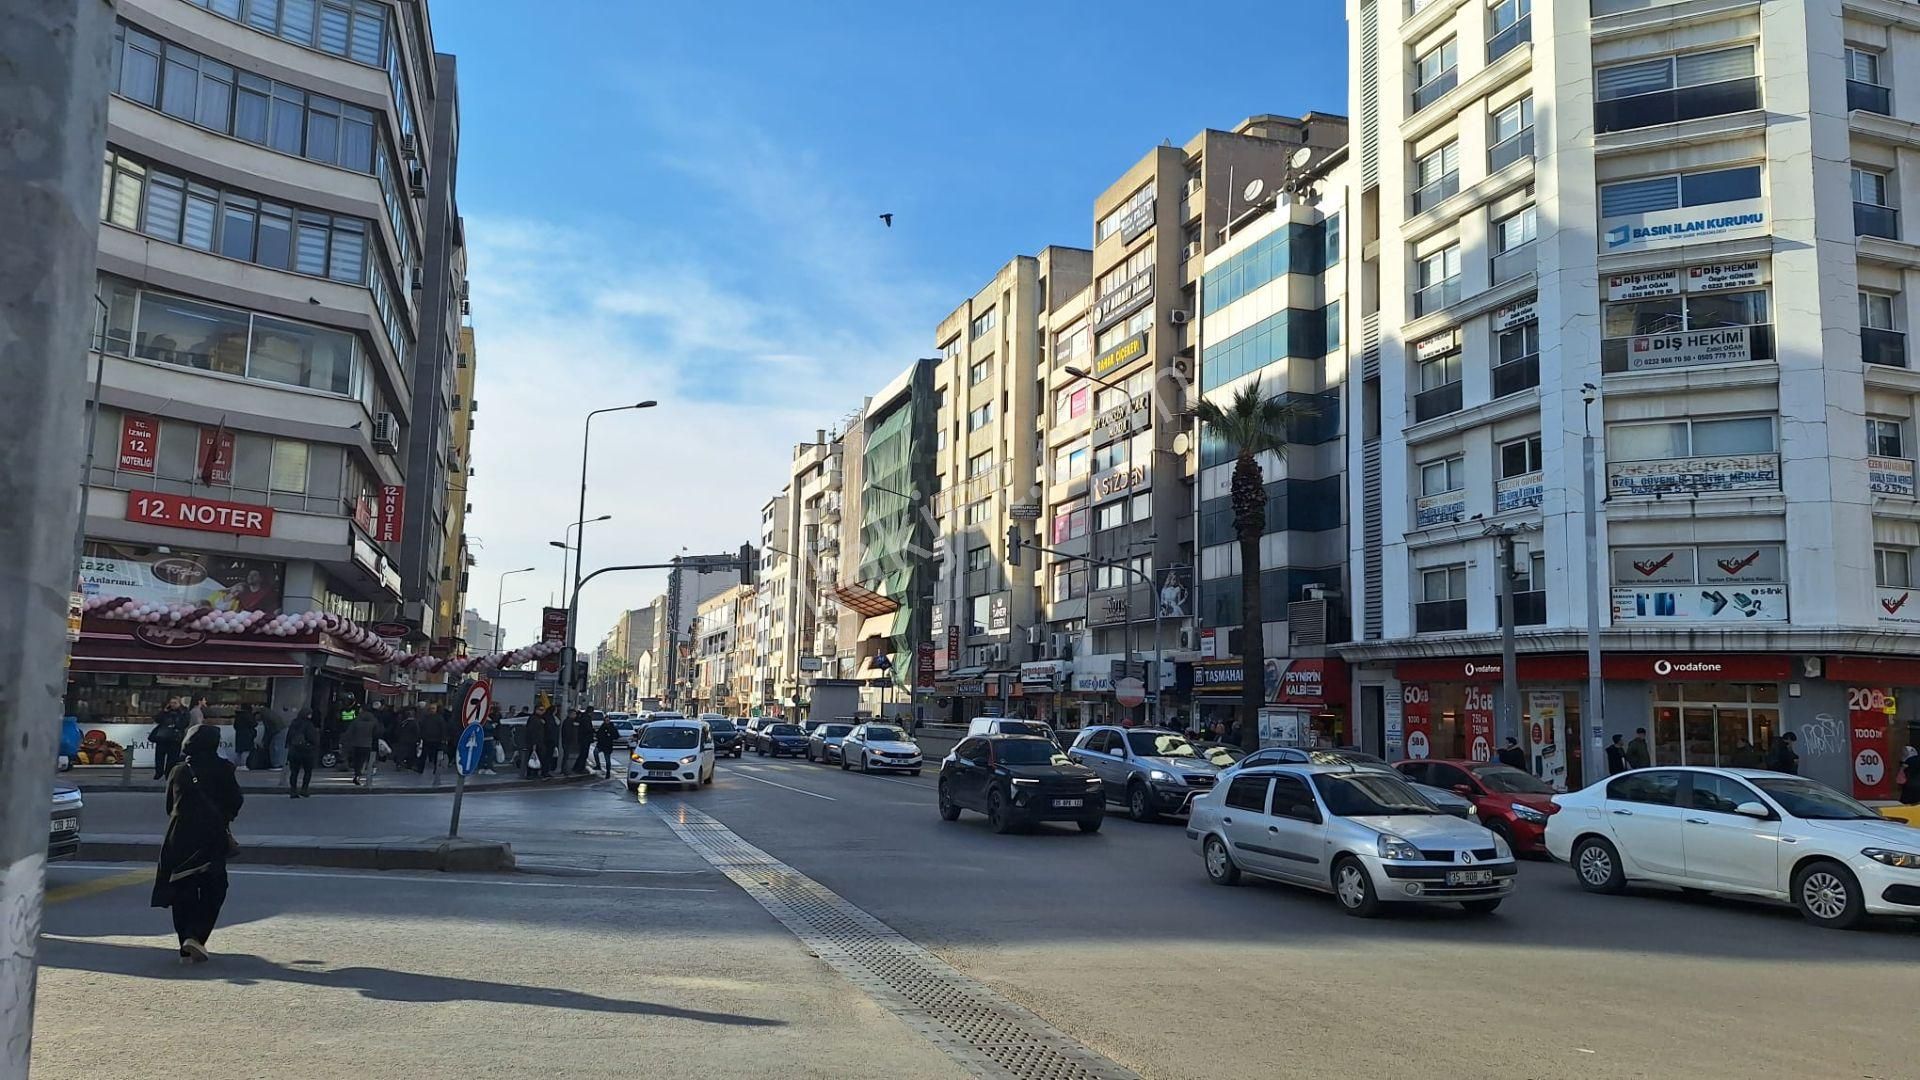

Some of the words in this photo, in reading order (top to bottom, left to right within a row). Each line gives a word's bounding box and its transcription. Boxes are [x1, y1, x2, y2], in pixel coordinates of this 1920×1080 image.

[1633, 223, 1672, 239] BASIN
[1674, 219, 1705, 234] İLAN
[1707, 213, 1763, 229] KURUMU
[1704, 265, 1722, 276] DİŞ
[1724, 261, 1759, 273] HEKİMİ
[1624, 275, 1641, 285] DİŞ
[1644, 271, 1676, 282] HEKİMİ
[1653, 336, 1682, 351] DİŞ
[1688, 329, 1744, 347] HEKİMİ
[130, 440, 148, 452] 12.
[383, 486, 400, 495] 12.
[138, 498, 170, 519] 12.
[179, 503, 263, 530] NOTER
[384, 496, 396, 541] NOTER
[1475, 664, 1501, 673] vodafone
[1673, 662, 1722, 672] vodafone
[1855, 728, 1875, 739] 1000
[1860, 754, 1879, 766] 300
[1865, 774, 1875, 783] TL
[1451, 873, 1461, 883] 35
